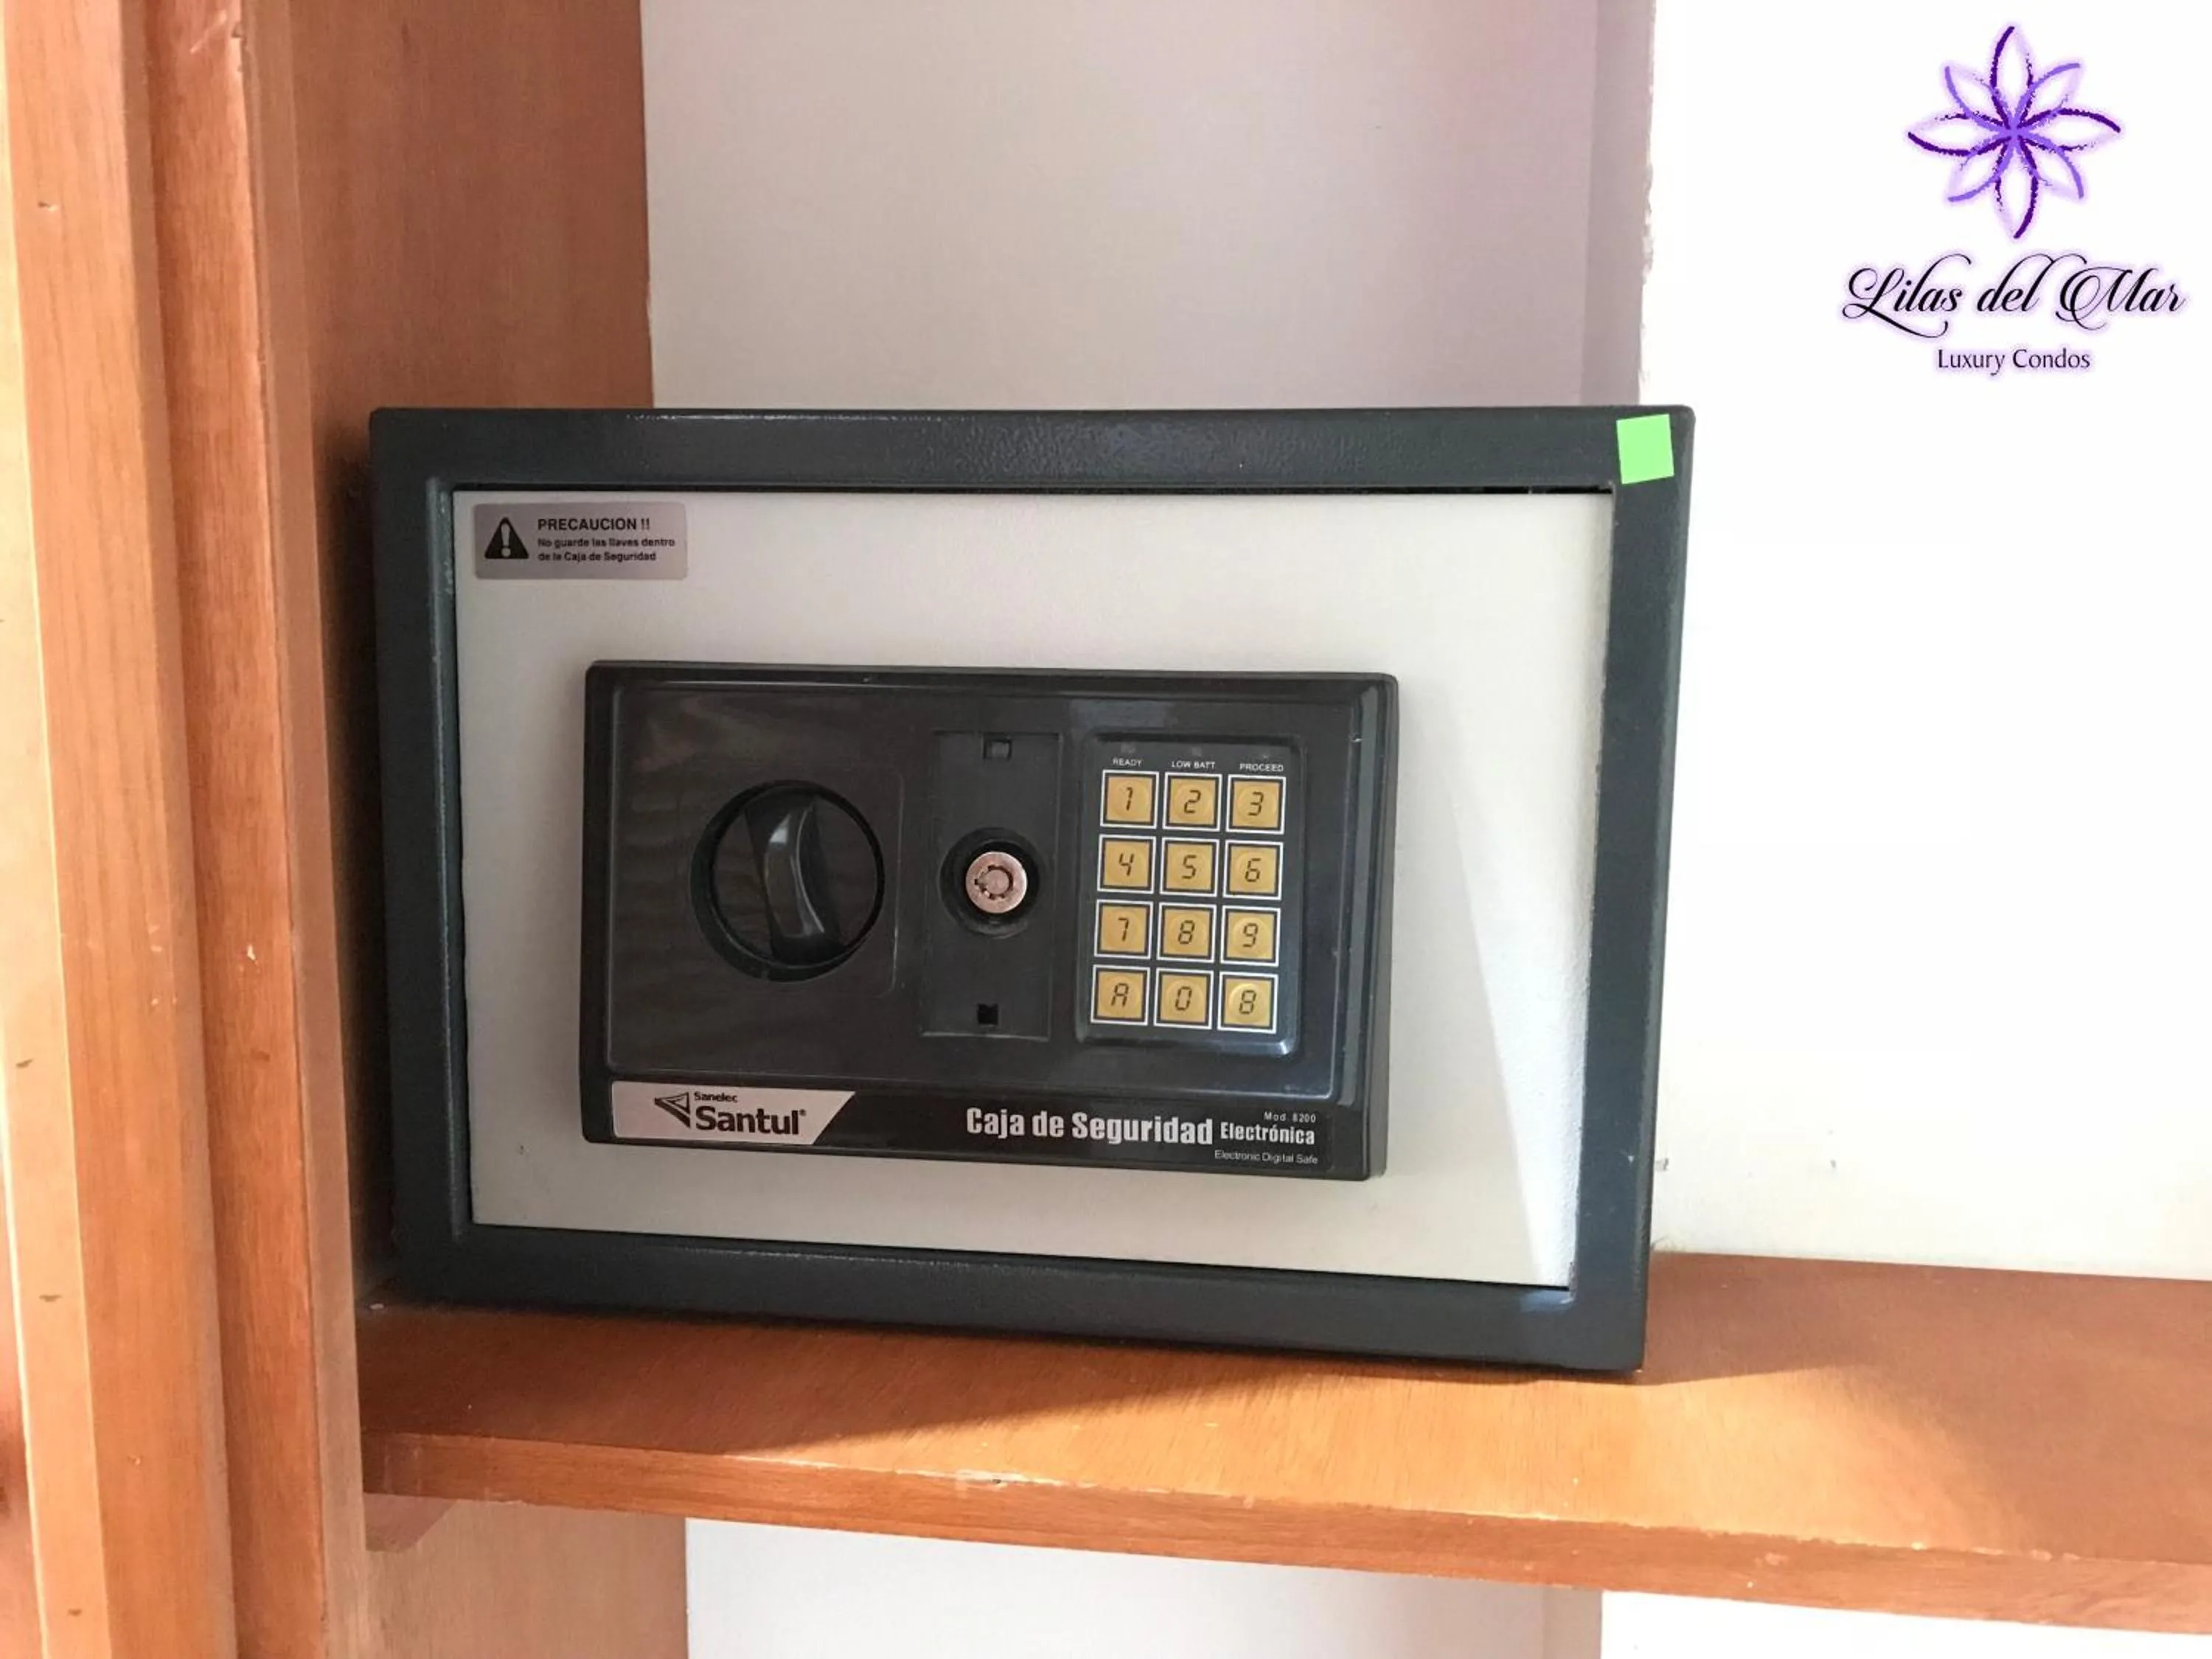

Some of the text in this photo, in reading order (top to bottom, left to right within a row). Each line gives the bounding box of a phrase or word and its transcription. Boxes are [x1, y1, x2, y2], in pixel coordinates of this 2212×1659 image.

[538, 518, 636, 531] PRECAUCION
[538, 538, 675, 549] No guarde las llaves dentro
[539, 553, 551, 561] de
[564, 552, 587, 562] Caja
[589, 552, 602, 561] de
[604, 552, 656, 563] Seguridad
[1112, 757, 1143, 767] READY
[1172, 760, 1216, 770] LOW BATT
[1239, 763, 1284, 772] PROCEED
[1125, 787, 1264, 816] 1 2 3
[1119, 852, 1262, 883] 4 5 6
[1118, 917, 1259, 947] 7 8 9
[1111, 983, 1129, 1007] A
[694, 1091, 737, 1102] Sanelec
[967, 1107, 1315, 1145] Caja de Seguridad Electrónica
[1214, 1150, 1318, 1164] Electronic Digital Safe
